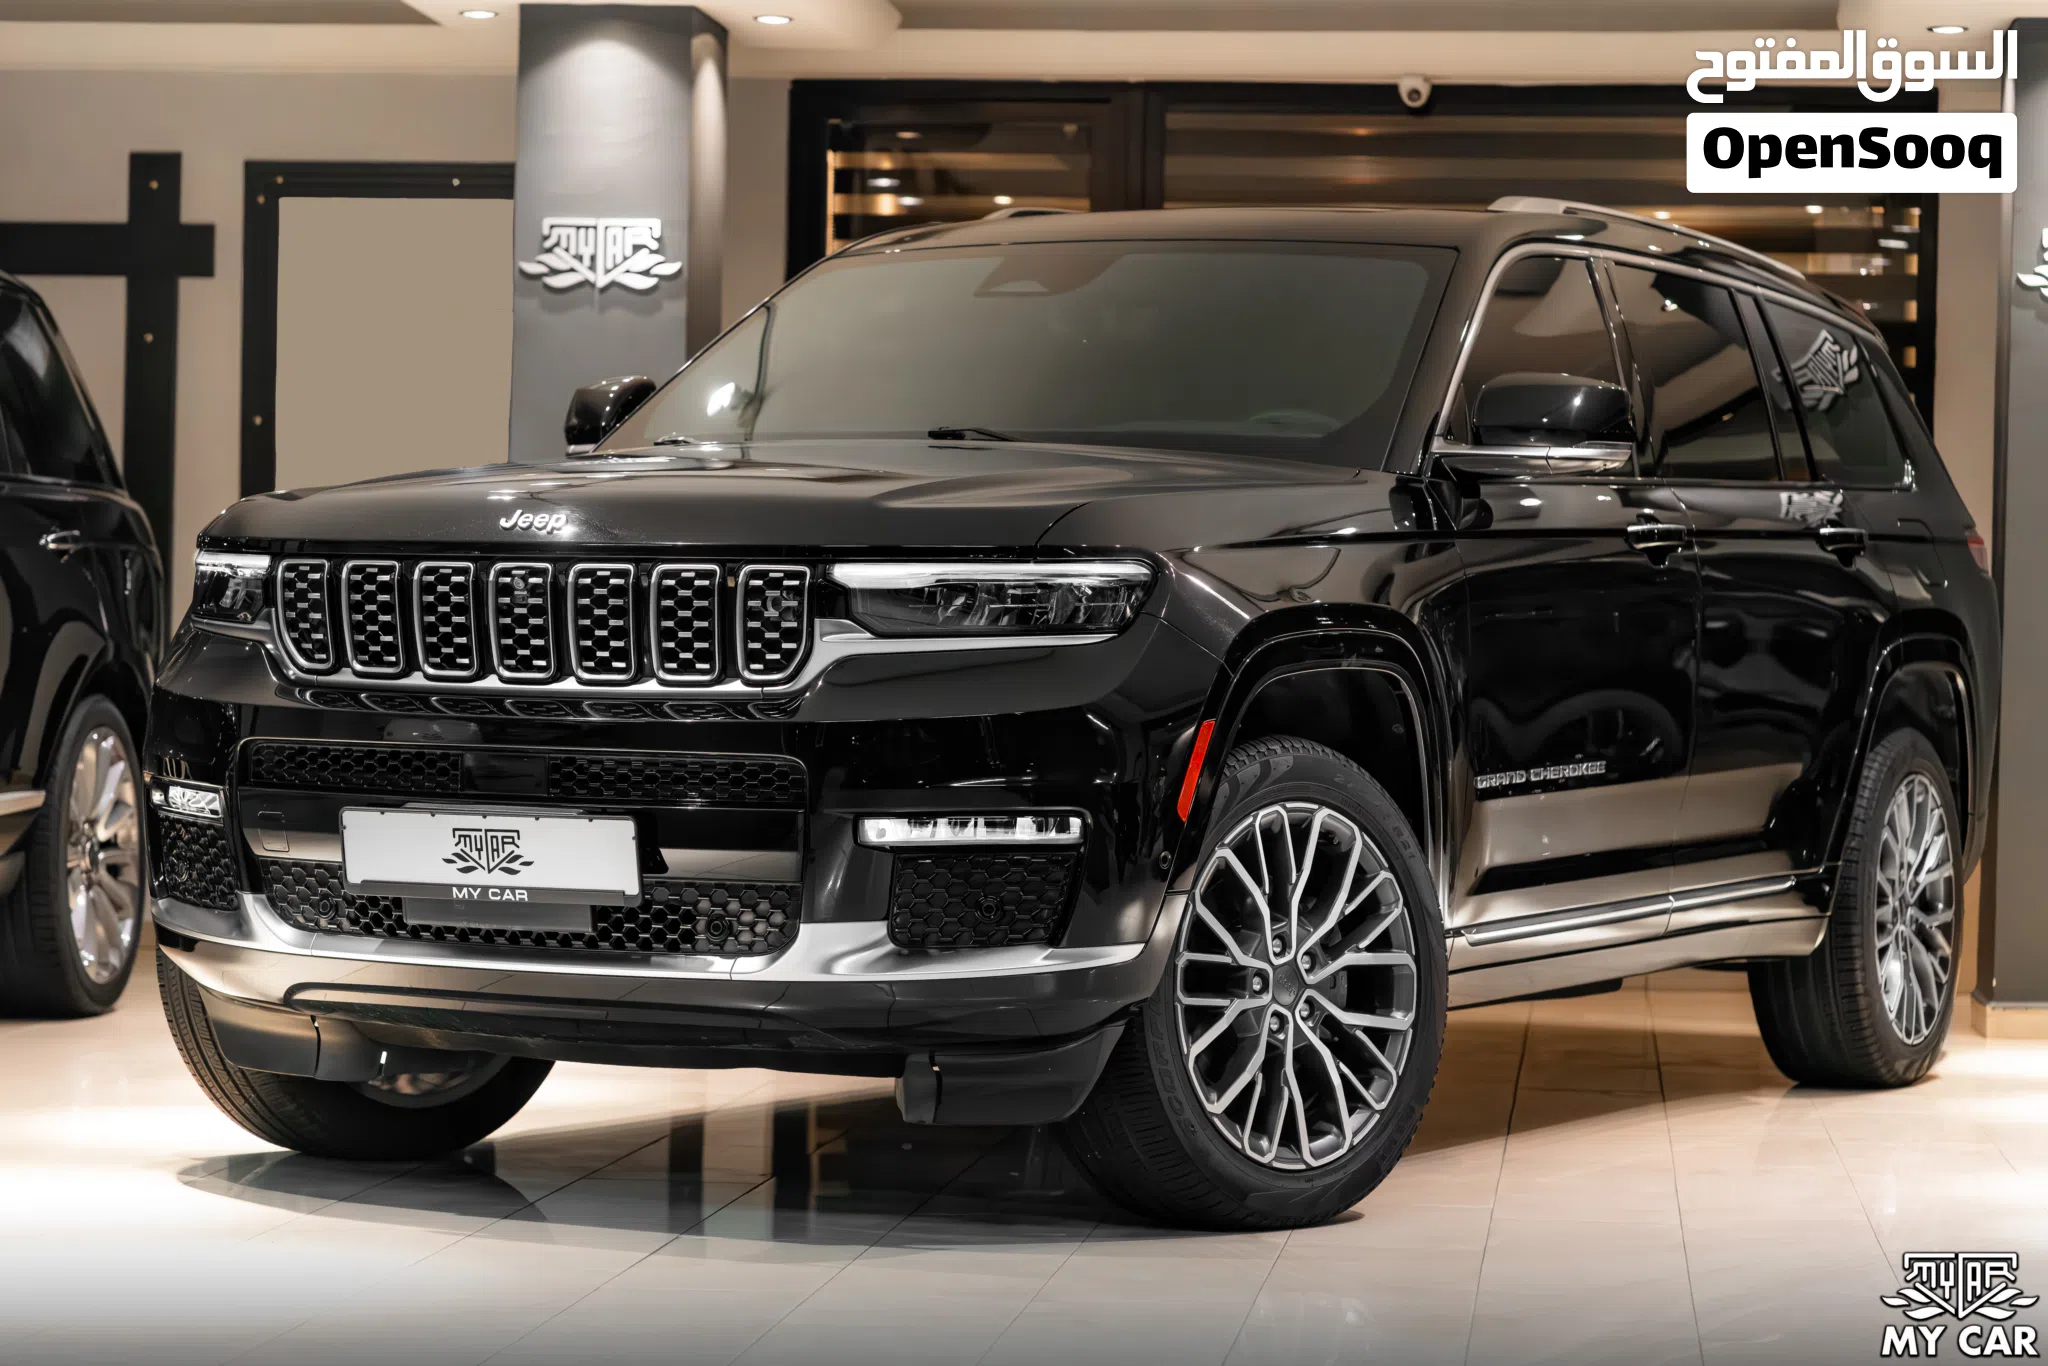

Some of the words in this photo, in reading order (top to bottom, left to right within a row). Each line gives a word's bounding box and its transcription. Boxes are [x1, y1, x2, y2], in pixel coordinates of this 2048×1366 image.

[499, 509, 567, 534] Jeep
[1476, 770, 1527, 789] GRAND
[1530, 760, 1607, 782] CHEROKEE
[452, 886, 482, 900] MY
[487, 888, 529, 902] CAR
